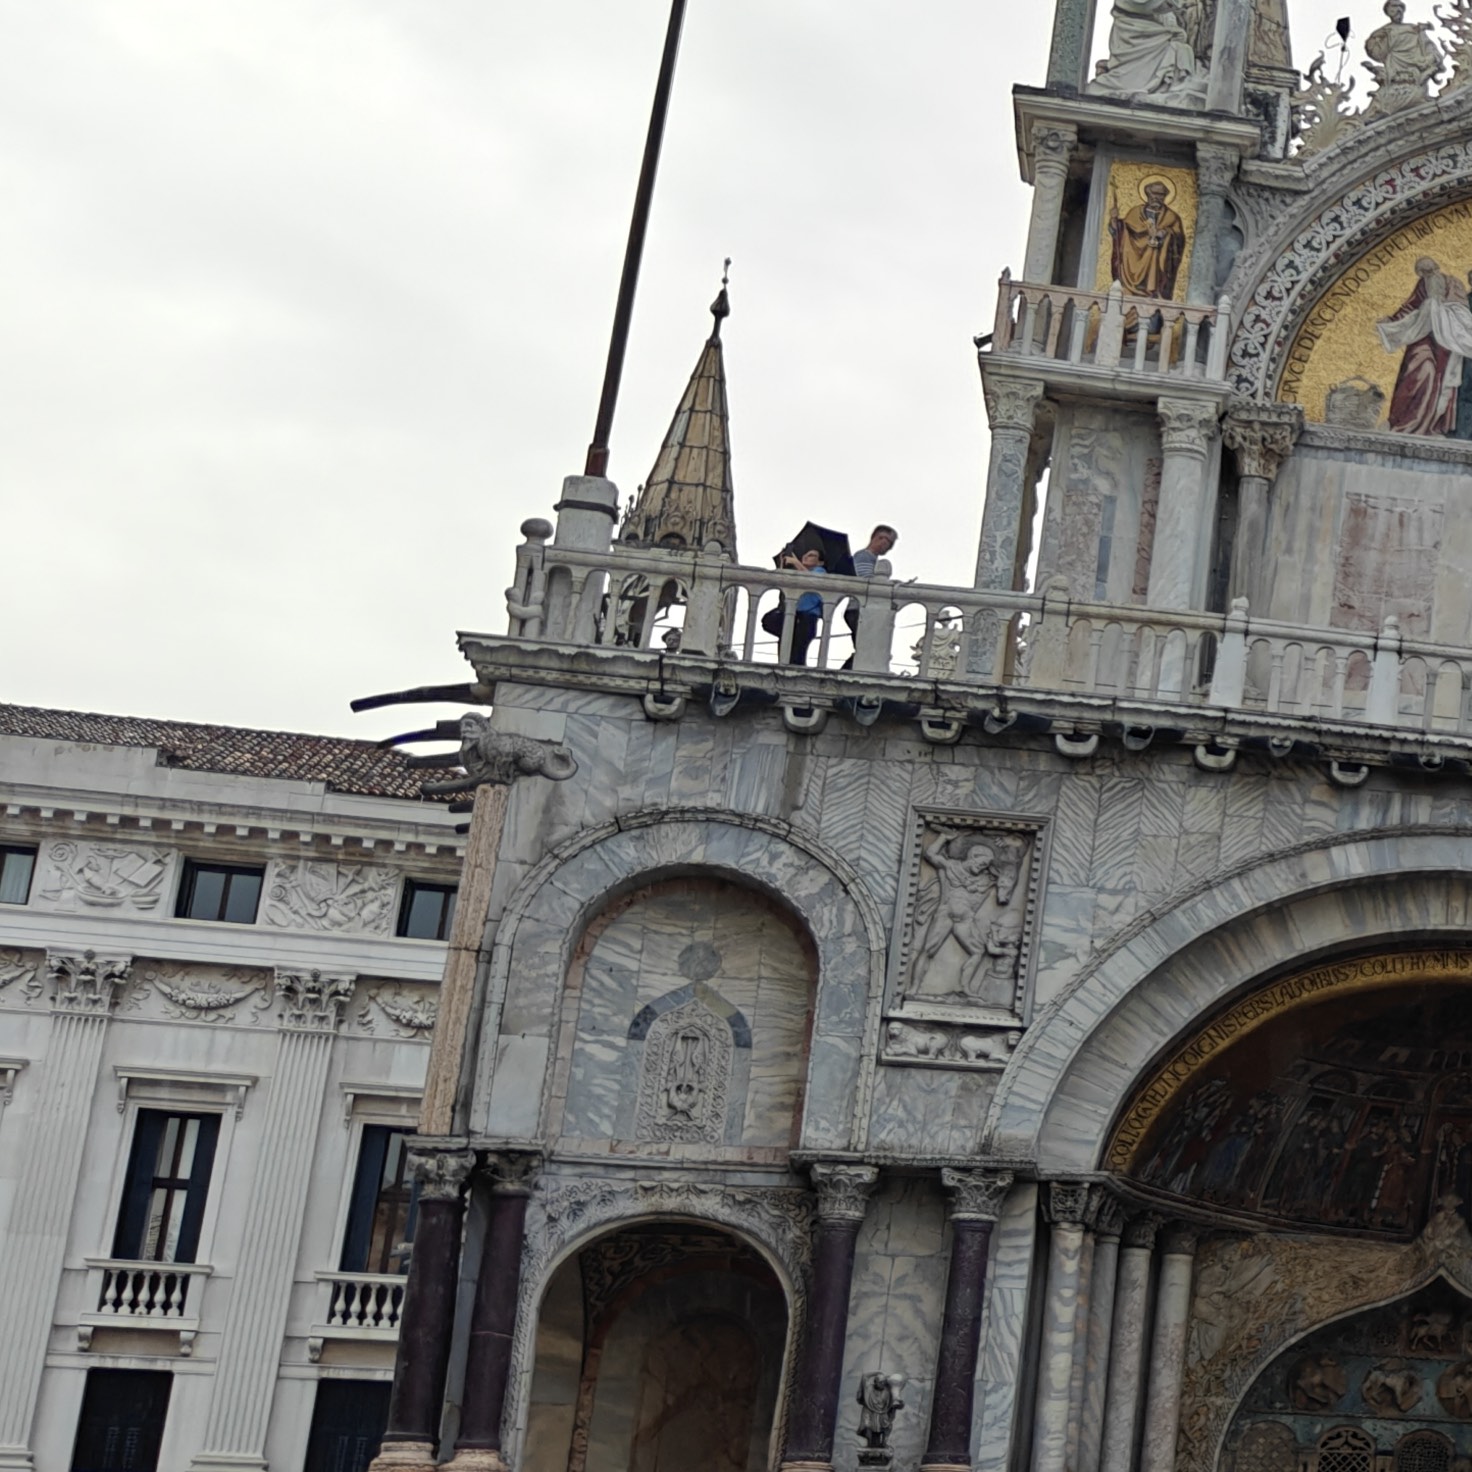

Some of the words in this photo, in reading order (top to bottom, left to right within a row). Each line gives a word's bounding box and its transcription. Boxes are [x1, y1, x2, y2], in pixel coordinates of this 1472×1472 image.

[1280, 347, 1311, 403] CRVCE
[1298, 260, 1372, 352] DESCENDO
[1430, 203, 1471, 231] CVM
